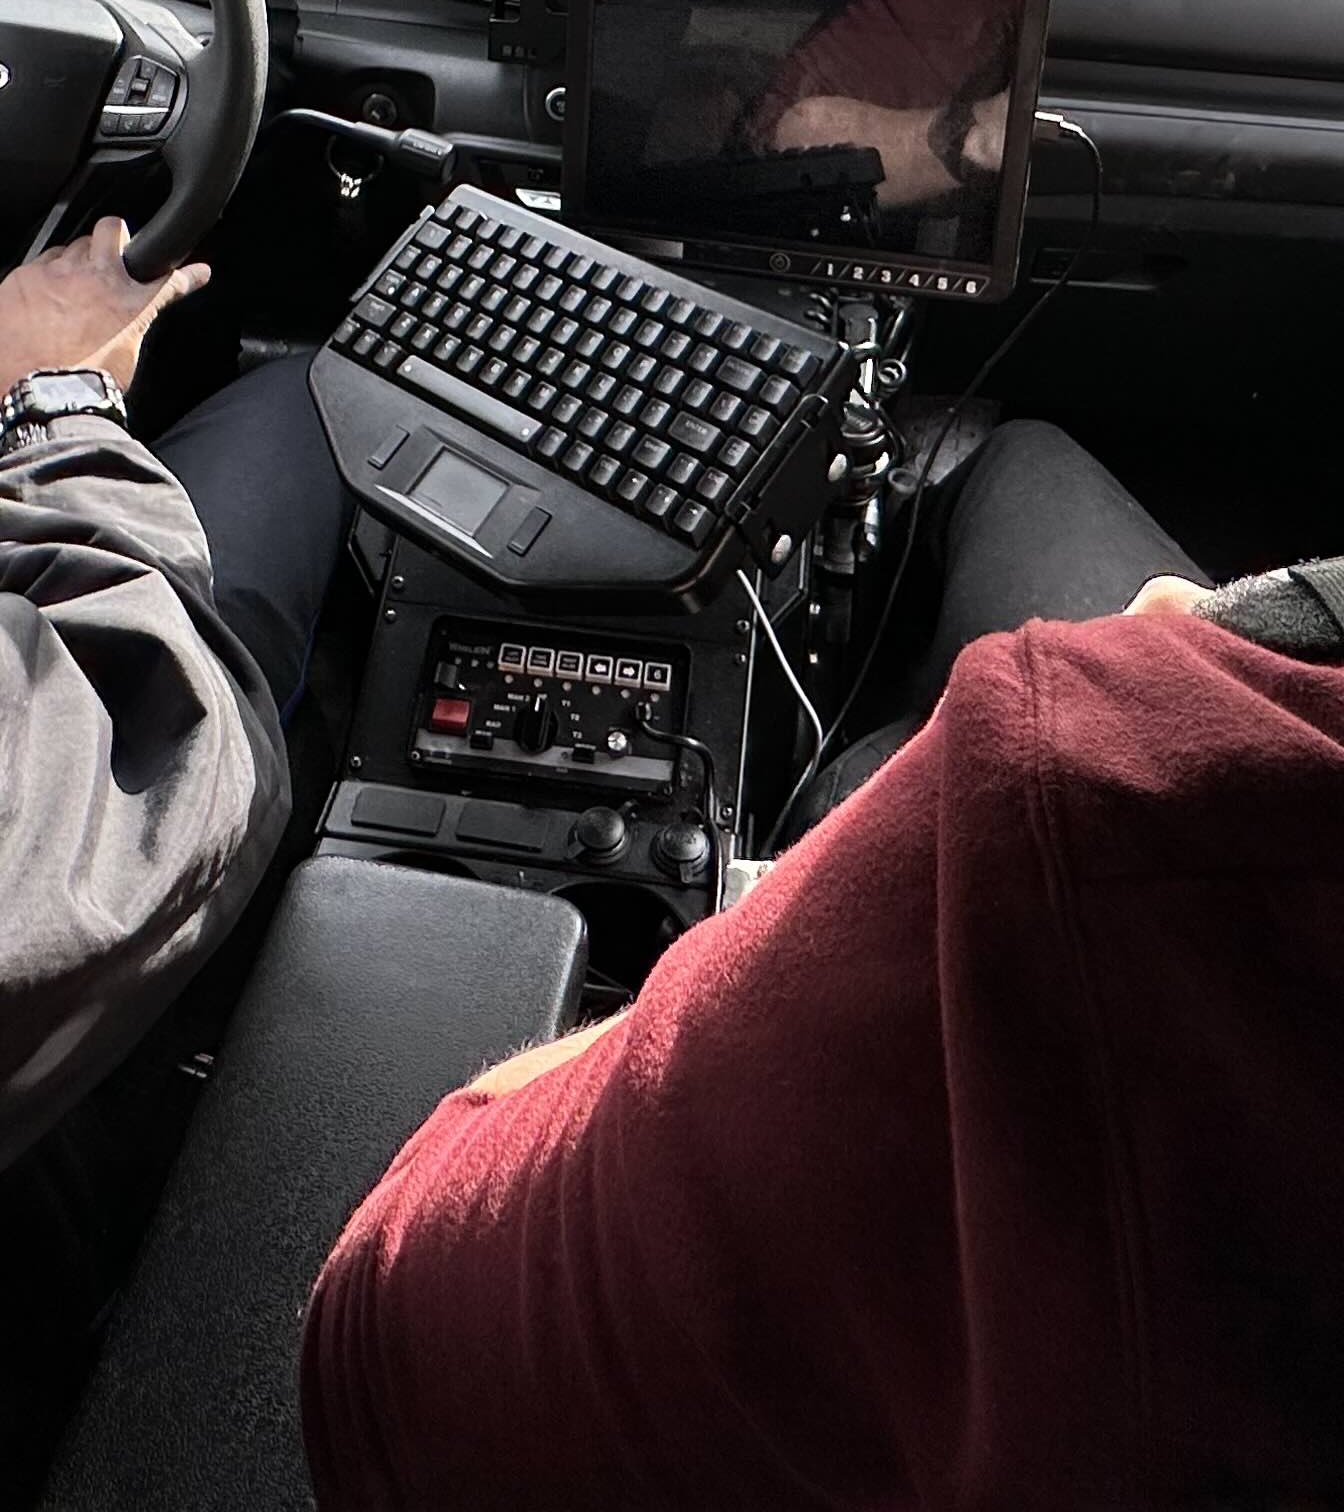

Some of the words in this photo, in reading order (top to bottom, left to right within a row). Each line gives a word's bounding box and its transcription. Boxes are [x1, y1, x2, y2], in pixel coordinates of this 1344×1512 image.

[827, 263, 833, 276] 1
[853, 266, 864, 280] 2
[881, 270, 891, 283] 3
[908, 274, 919, 287] 4
[937, 277, 948, 290] 5
[966, 281, 977, 294] 6
